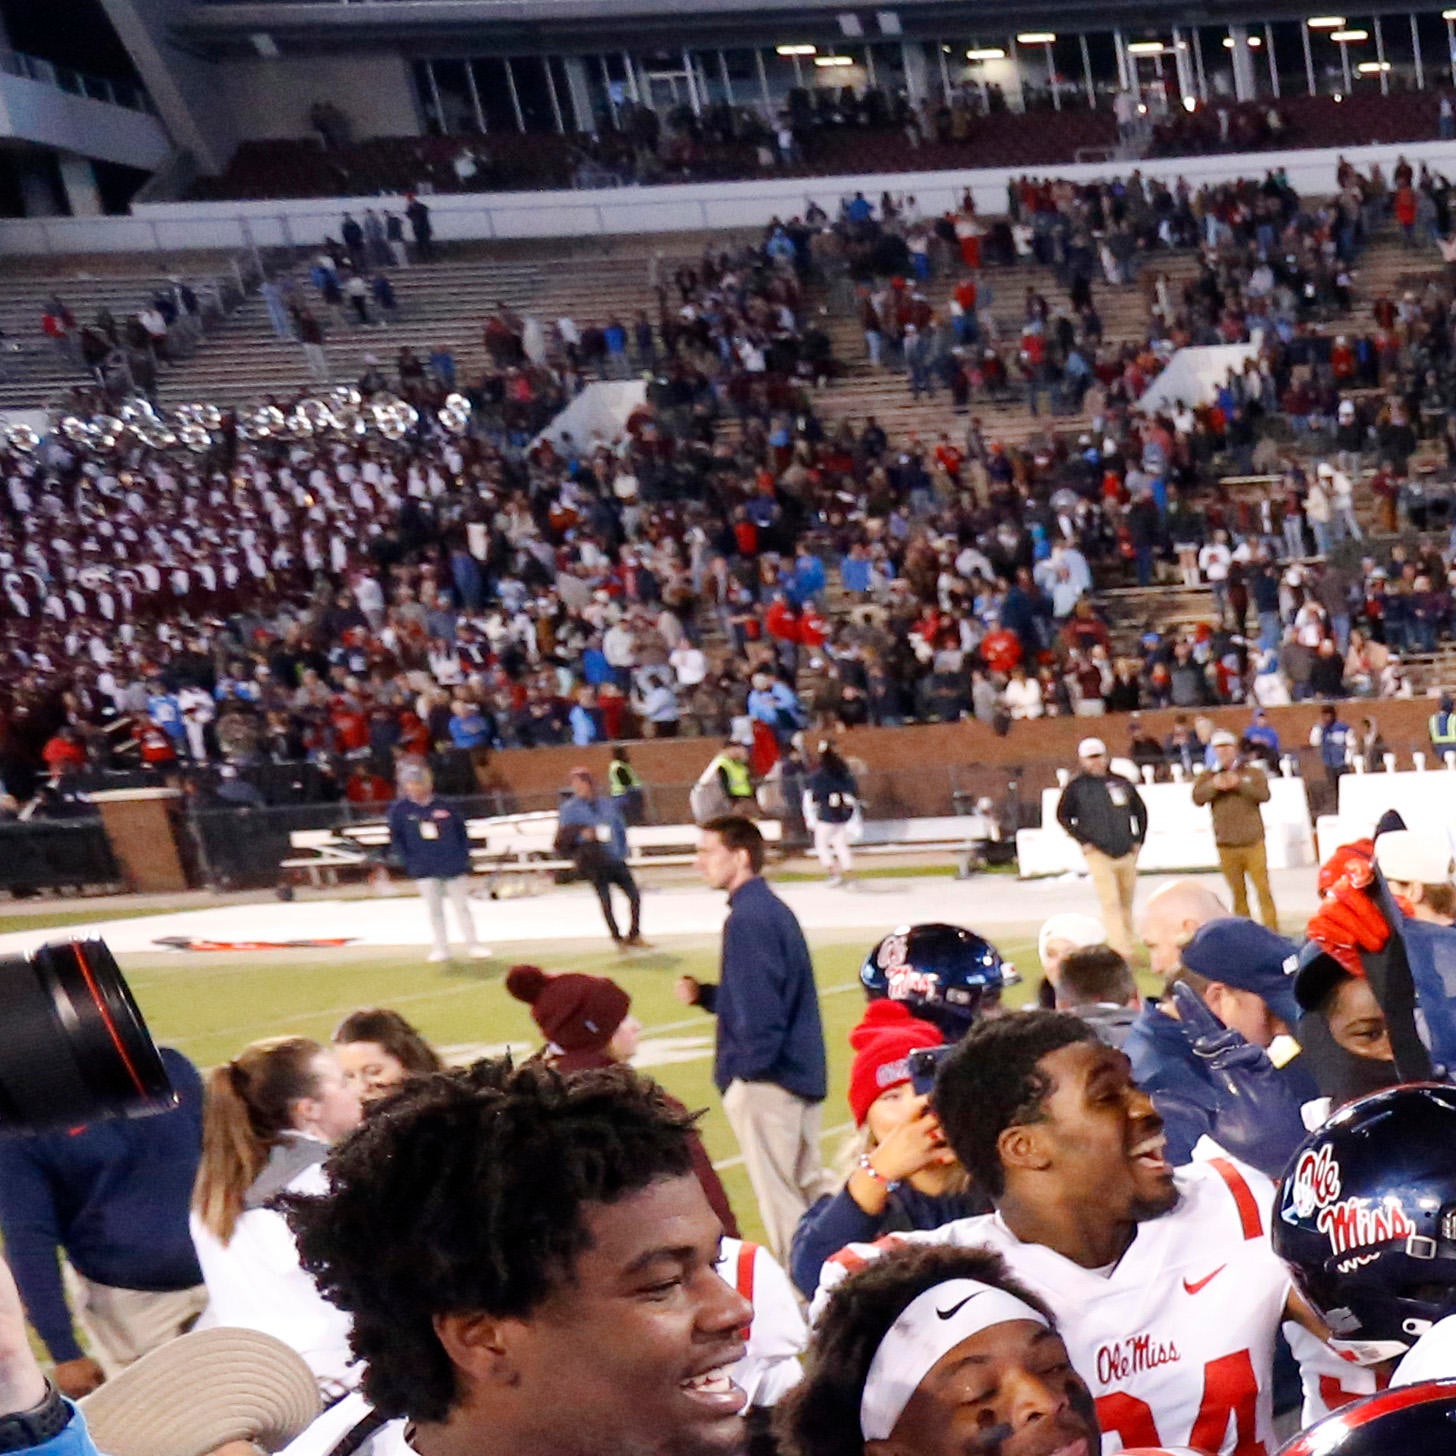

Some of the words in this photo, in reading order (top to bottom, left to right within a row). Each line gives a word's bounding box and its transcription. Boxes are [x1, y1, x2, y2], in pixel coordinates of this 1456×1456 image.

[1292, 1142, 1340, 1220] Ole
[1316, 1196, 1417, 1273] Miss
[1096, 1343, 1131, 1384] Ole
[1126, 1334, 1182, 1376] Miss
